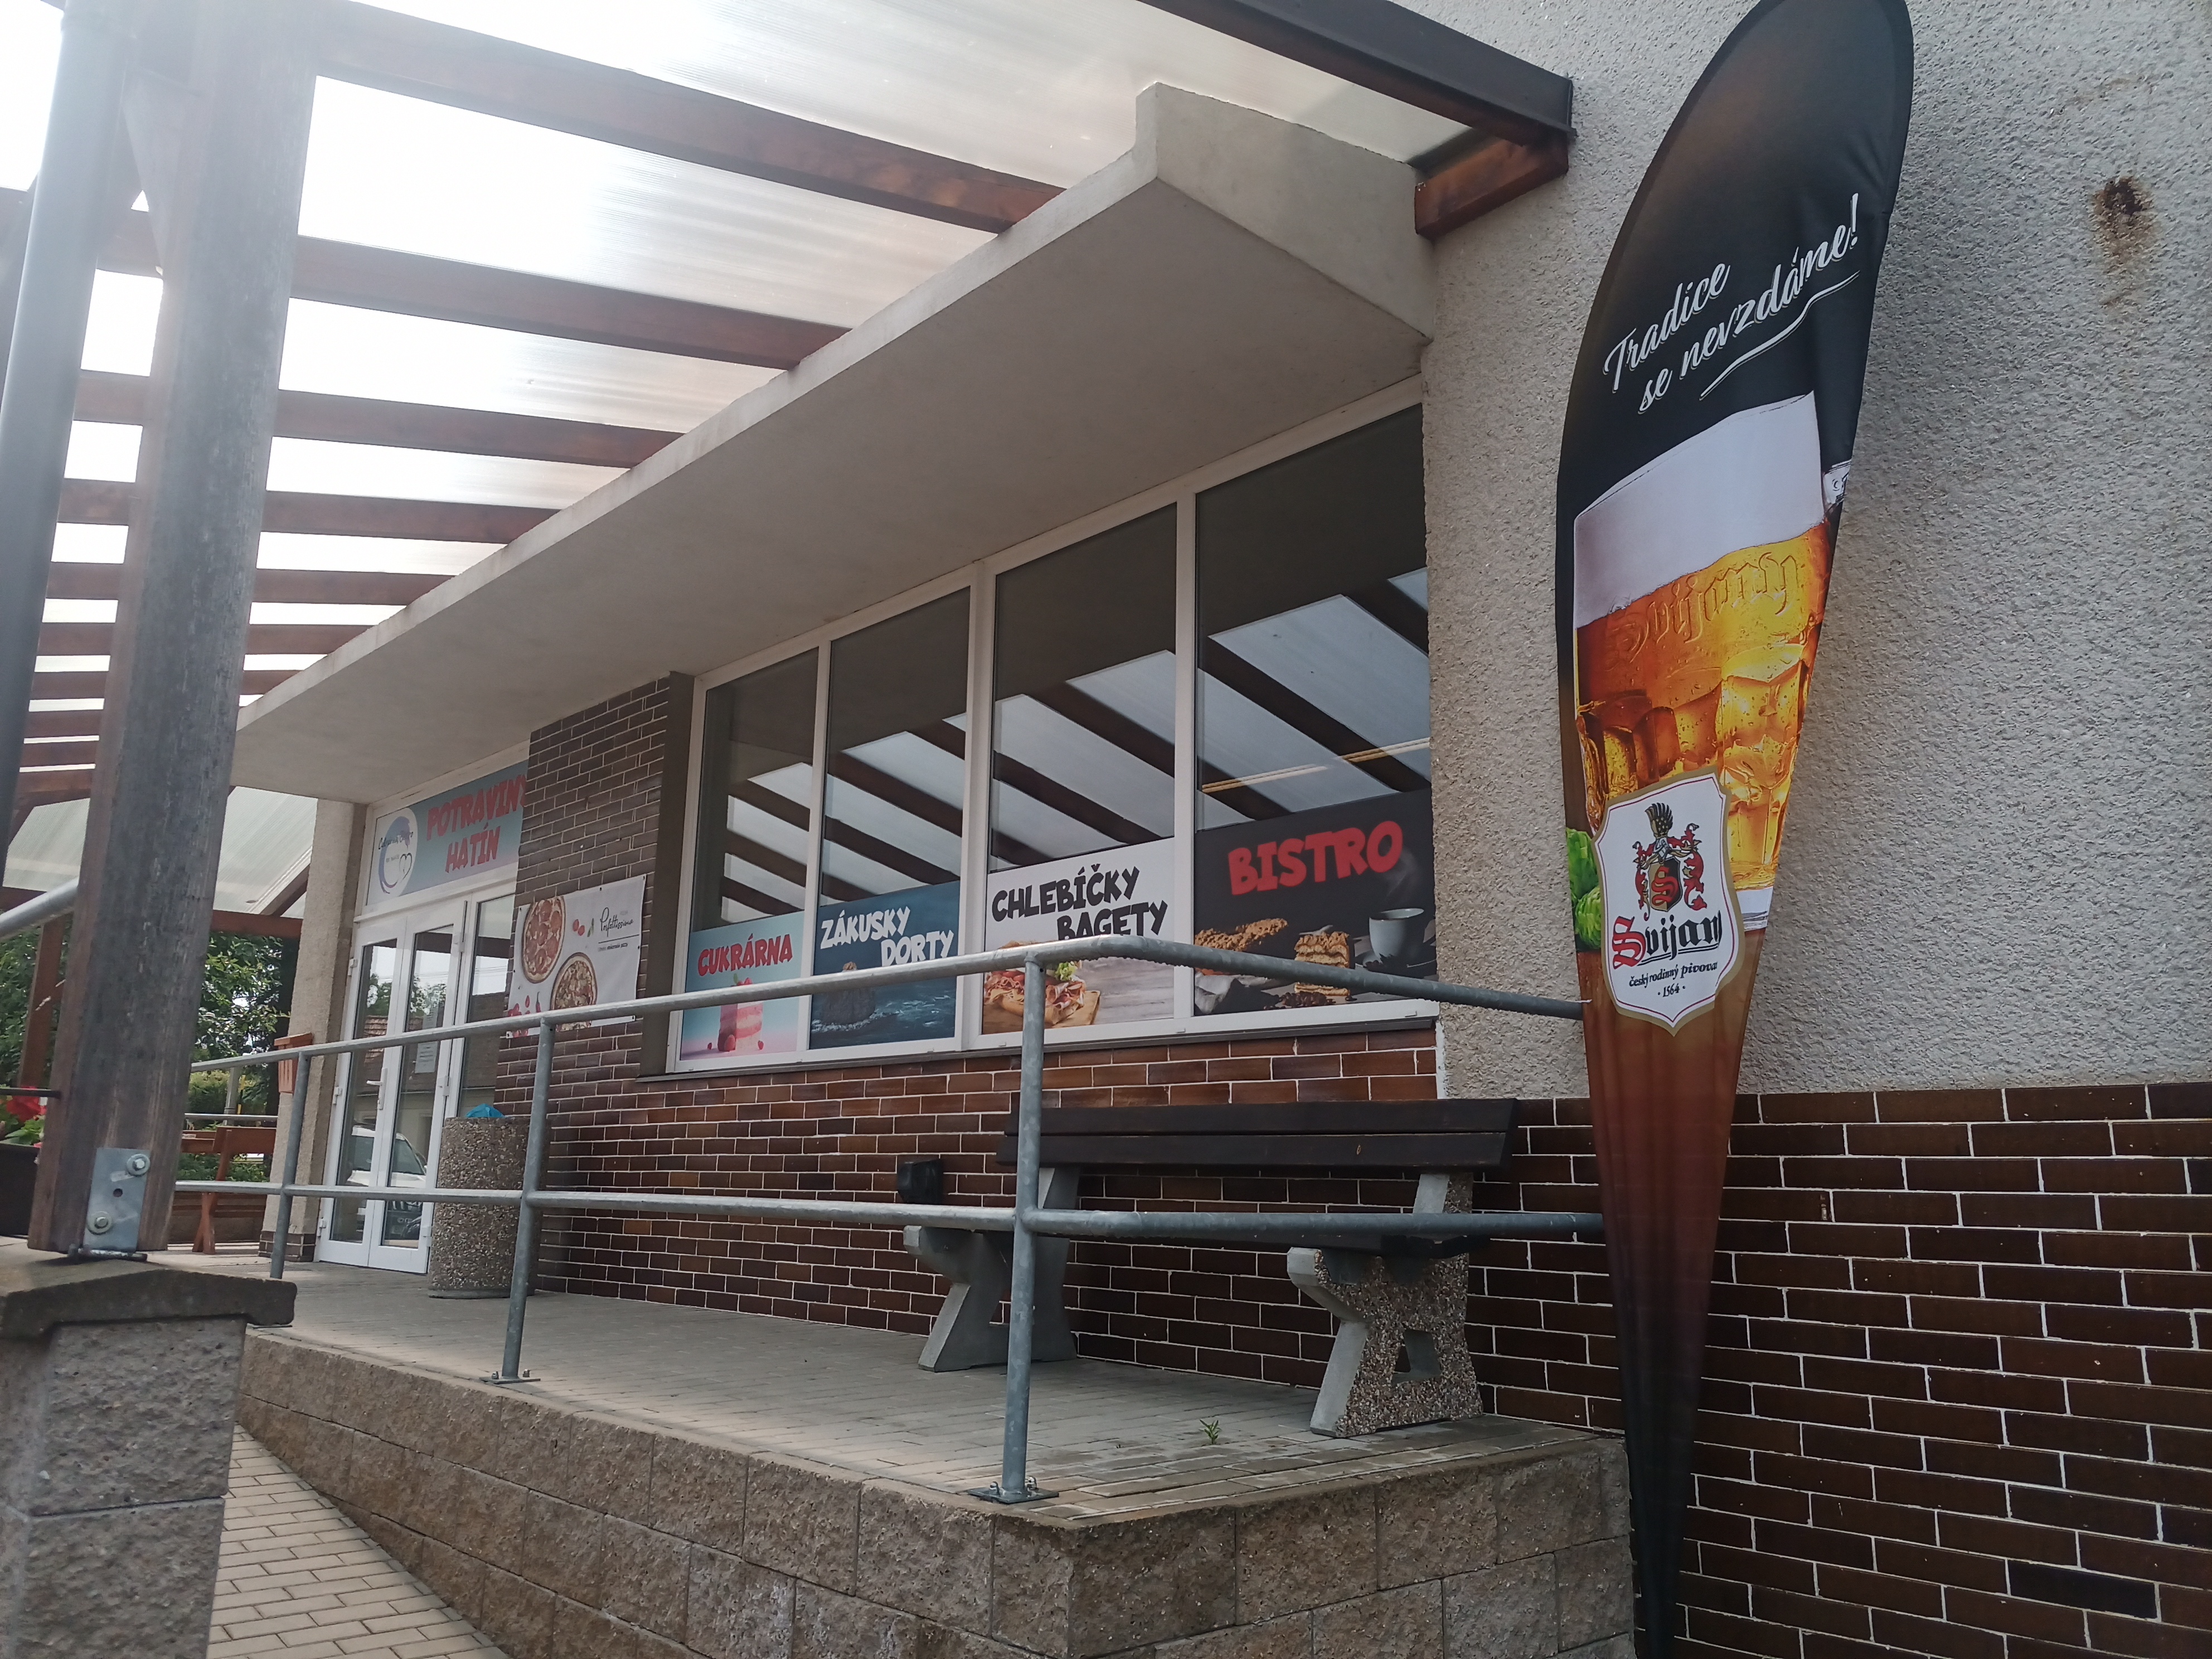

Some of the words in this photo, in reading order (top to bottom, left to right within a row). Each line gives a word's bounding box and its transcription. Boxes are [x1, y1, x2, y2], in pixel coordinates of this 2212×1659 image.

[1638, 368, 1672, 414] se
[1680, 193, 1859, 380] nevzdáme!
[1603, 263, 1730, 392] Tradice
[445, 822, 501, 873] HATÍN
[1229, 820, 1404, 895] BISTRO
[991, 863, 1139, 922] CHLEBÍČKY
[821, 906, 910, 949] ZÁKUSKY
[1057, 900, 1168, 940] BAGETY
[698, 933, 793, 976] CUKRÁRNA
[881, 929, 954, 967] DORTY
[1629, 972, 1648, 988] český
[1663, 983, 1680, 997] 1564
